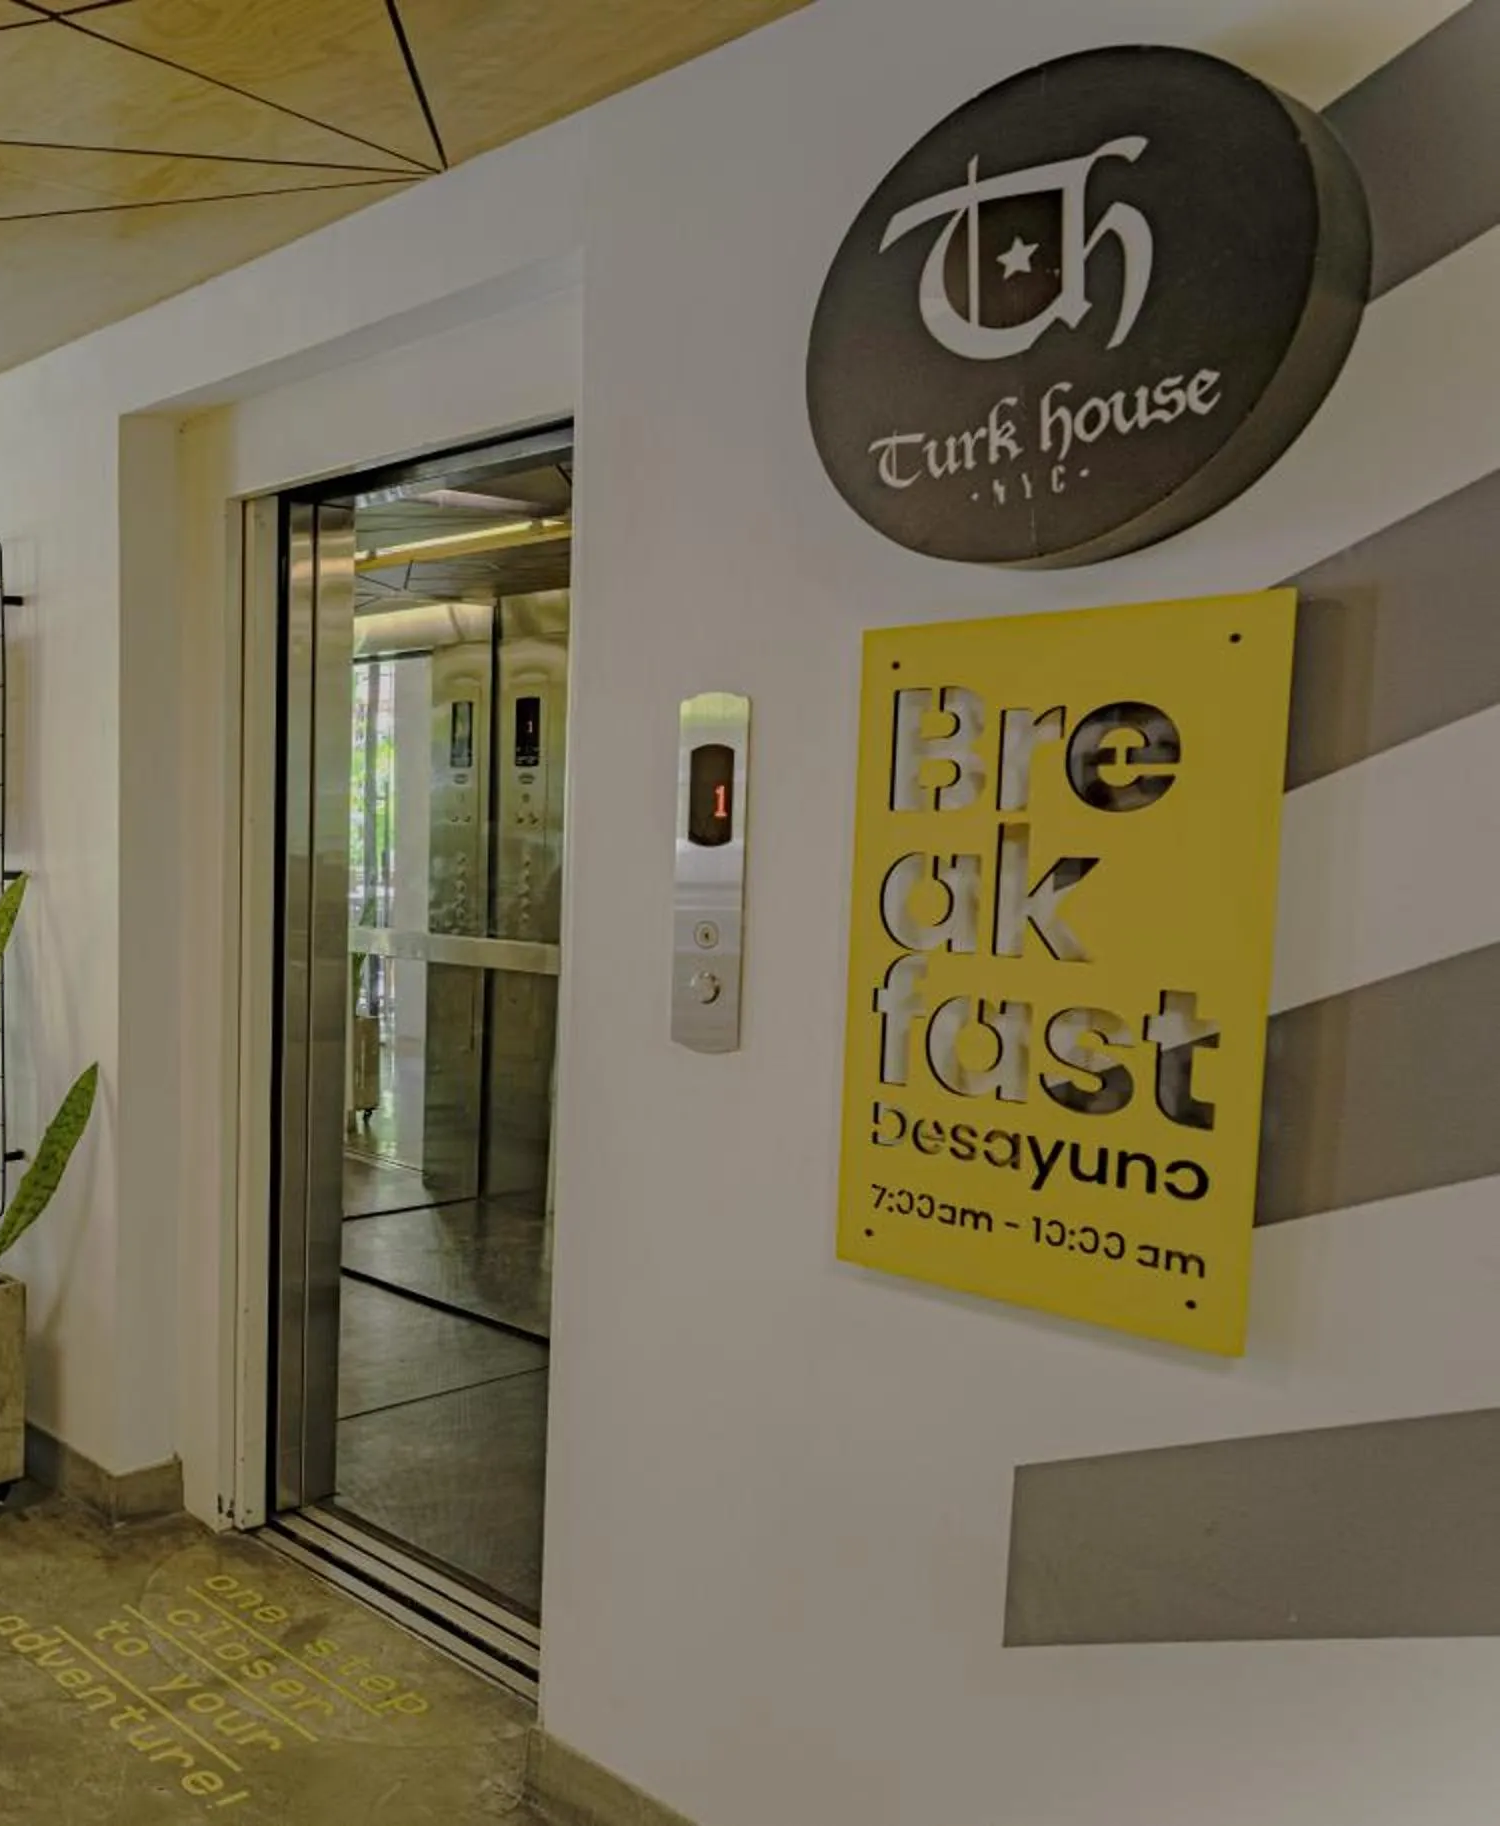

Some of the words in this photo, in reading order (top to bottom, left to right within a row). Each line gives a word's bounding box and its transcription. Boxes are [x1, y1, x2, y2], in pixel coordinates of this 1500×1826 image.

[868, 396, 1024, 489] Turk
[1041, 368, 1221, 461] house
[714, 784, 728, 817] 1
[889, 685, 1182, 813] Bre
[878, 822, 1101, 962] ak
[872, 952, 1221, 1131] fast
[871, 1101, 1210, 1201] Desayuno
[1136, 1244, 1206, 1279] am
[94, 1619, 150, 1657] to
[148, 1672, 282, 1752] your
[167, 1609, 334, 1716] closer
[204, 1574, 288, 1623] one
[303, 1638, 429, 1714] step
